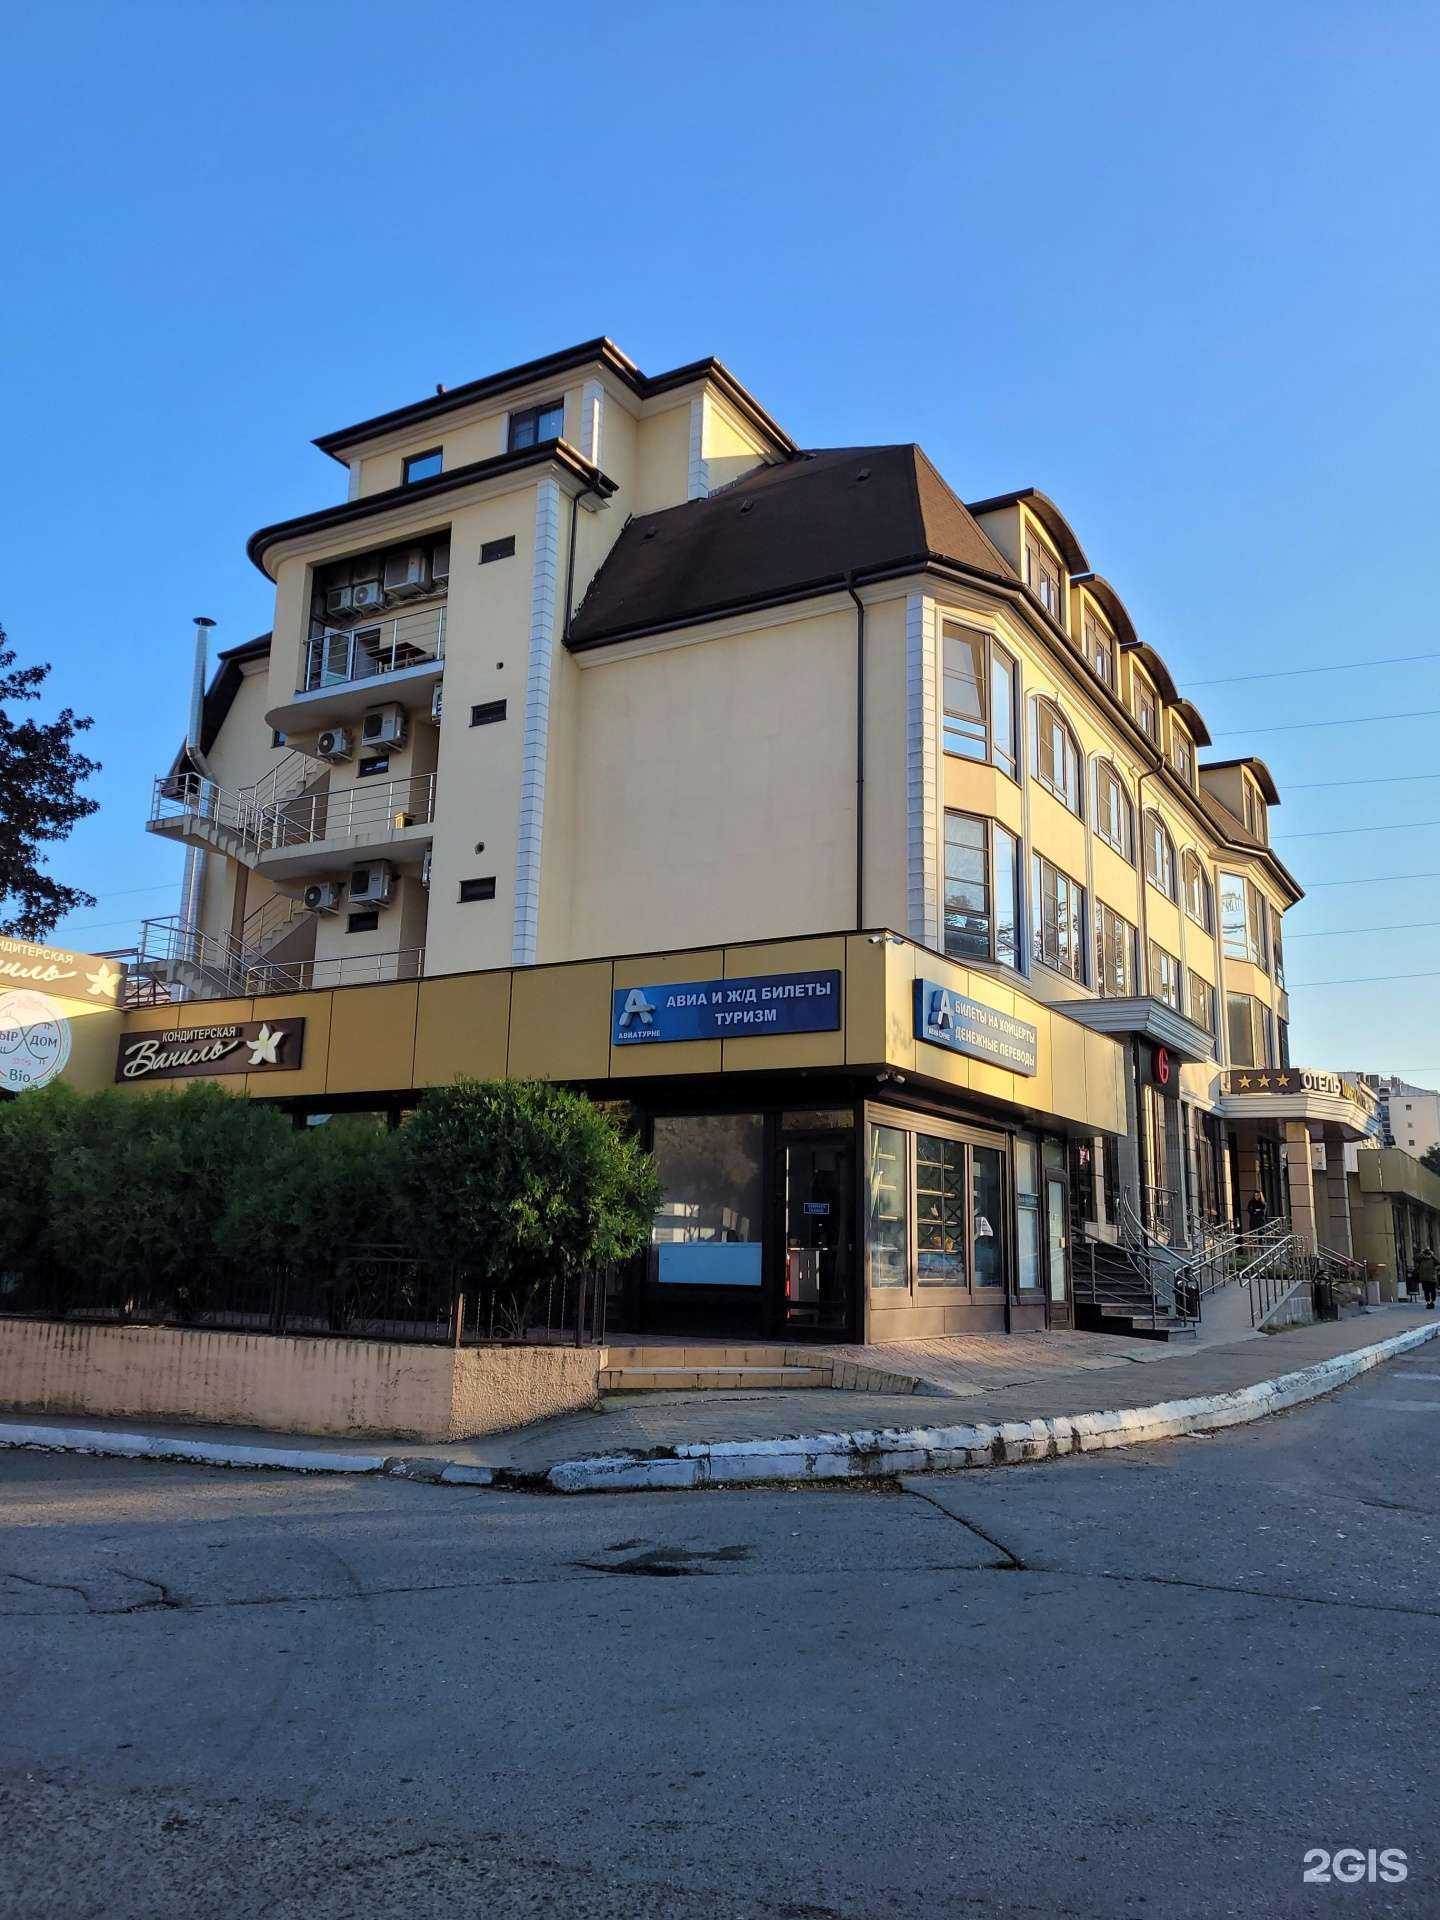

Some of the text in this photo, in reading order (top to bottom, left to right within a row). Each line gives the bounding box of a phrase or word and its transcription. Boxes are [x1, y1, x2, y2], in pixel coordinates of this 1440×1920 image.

[666, 982, 831, 1009] АВИА И Ж/Д БИЛЕТЫ
[715, 1009, 777, 1026] ТУРИЗМ
[954, 1000, 1035, 1043] БИЛЕТЫ НА КОНЦЕРТЫ
[30, 1035, 57, 1047] ДОМ
[162, 1026, 236, 1043] КОНДИТЕРСКАЯ
[123, 1039, 239, 1077] Ваниль
[955, 1026, 998, 1054] ДЕНЕЖНЫЕ
[1000, 1043, 1035, 1068] ПЕРЕВОДЫ
[9, 1068, 31, 1083] Bio
[1303, 1072, 1341, 1095] ОТЕЛЬ
